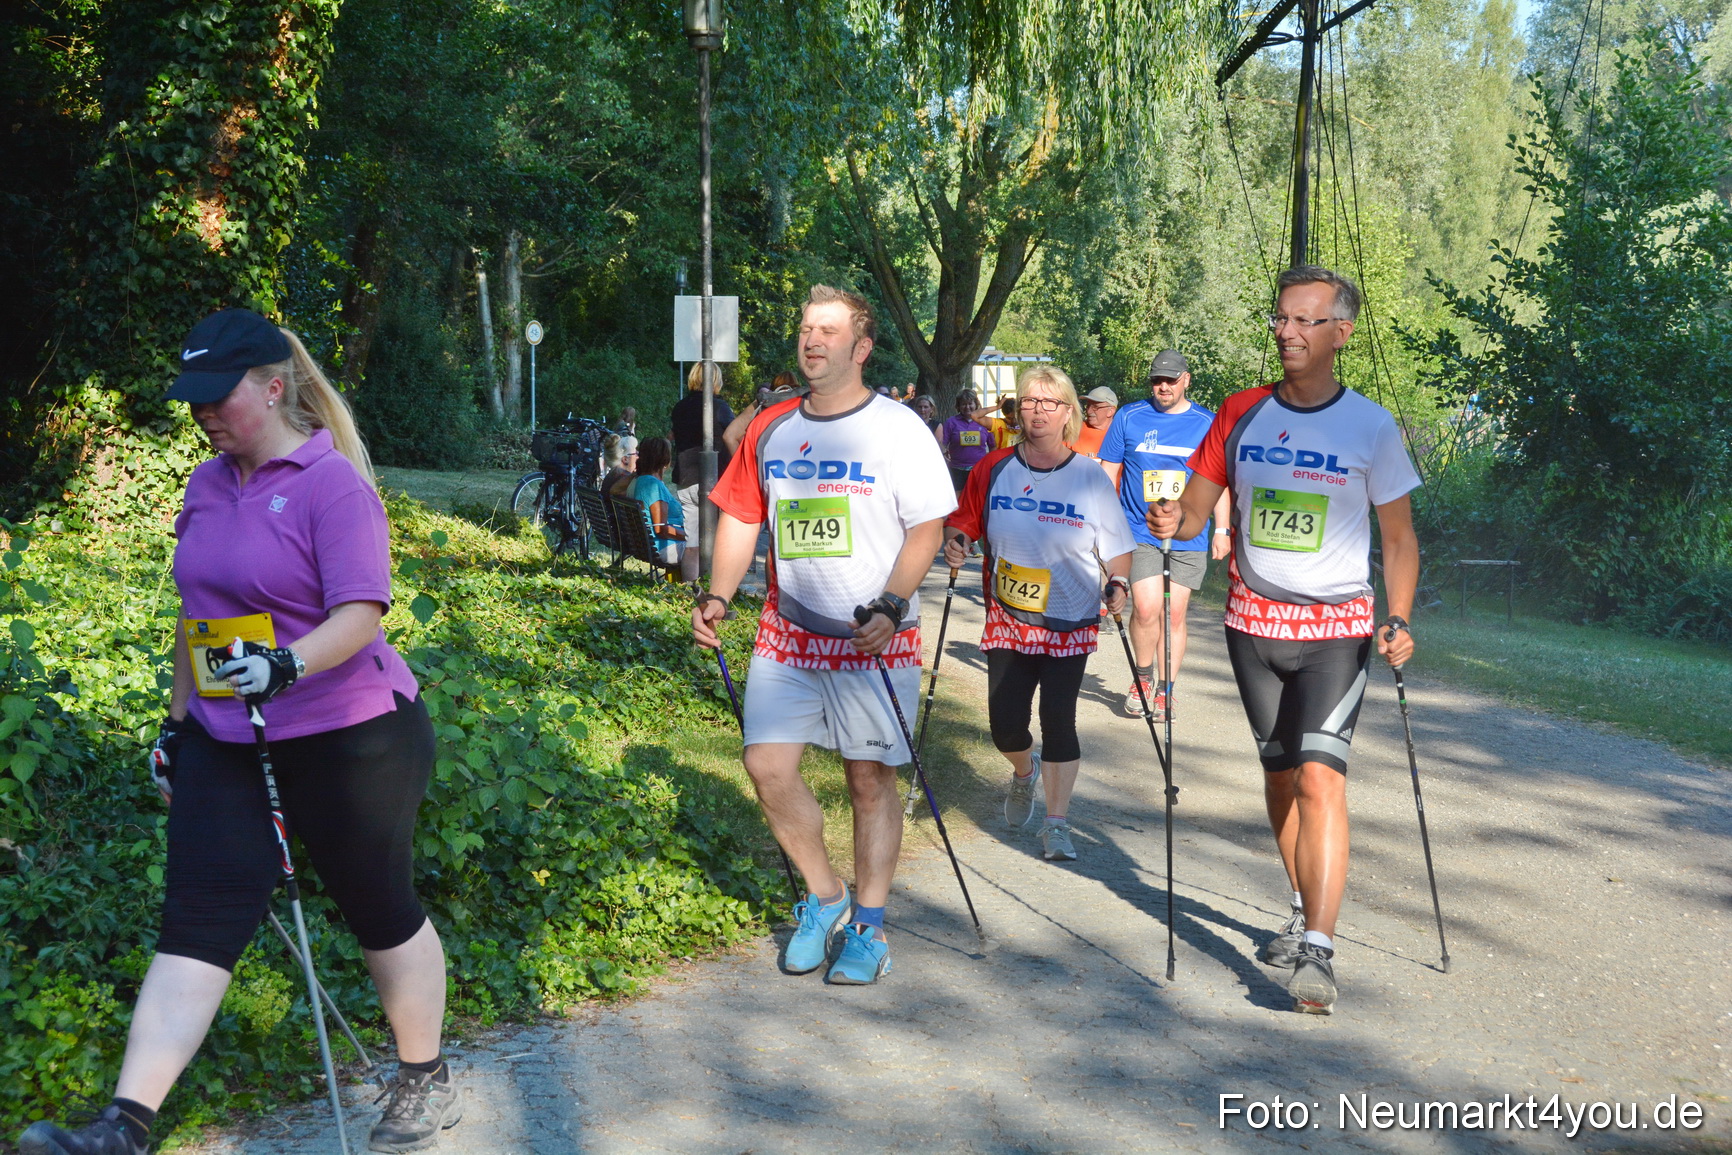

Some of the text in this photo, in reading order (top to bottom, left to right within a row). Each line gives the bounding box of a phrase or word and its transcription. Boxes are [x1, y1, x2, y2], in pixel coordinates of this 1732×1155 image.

[1293, 470, 1347, 486] energie
[817, 480, 873, 496] energie
[787, 518, 840, 540] 1749
[1038, 514, 1084, 528] energie
[1259, 509, 1314, 535] 1743
[1002, 575, 1041, 599] 1742
[1266, 605, 1315, 620] AVIA
[1025, 629, 1061, 646] AVIA
[1249, 620, 1295, 639] AVIA
[1297, 618, 1351, 640] AVIA
[866, 739, 894, 750] saller
[262, 763, 280, 807] LEKI
